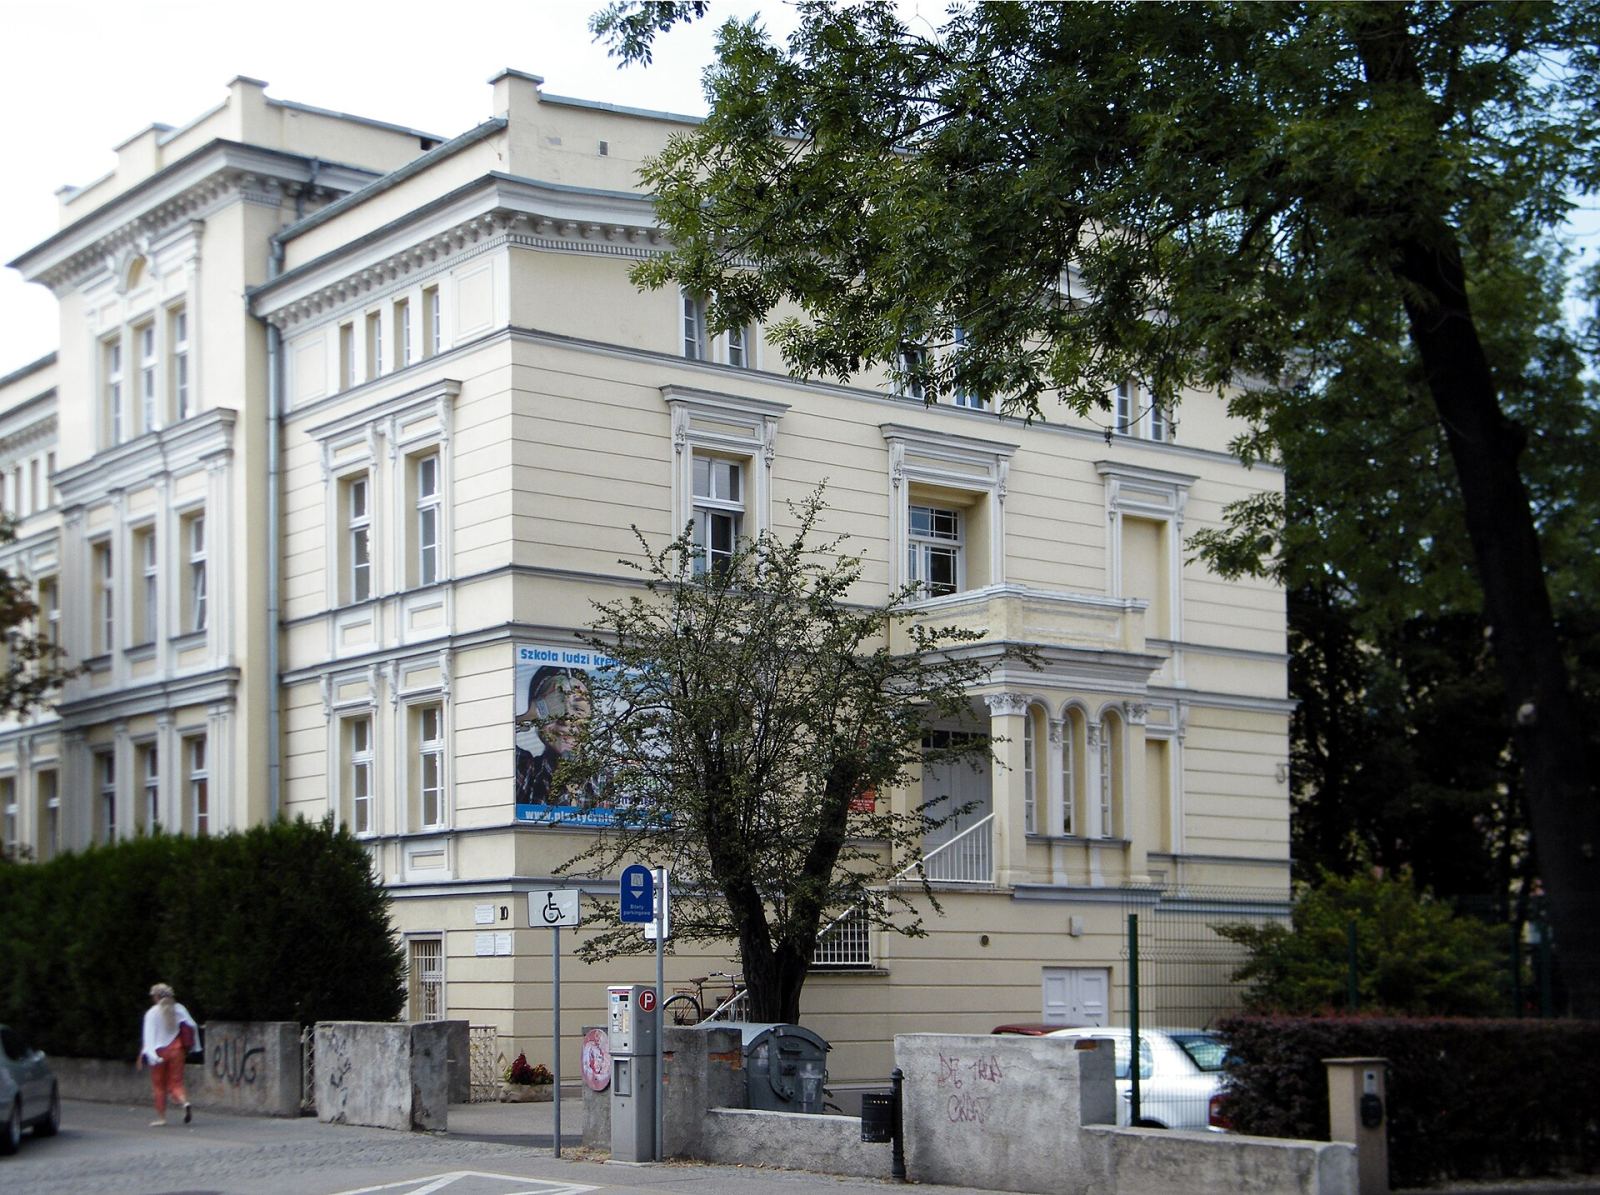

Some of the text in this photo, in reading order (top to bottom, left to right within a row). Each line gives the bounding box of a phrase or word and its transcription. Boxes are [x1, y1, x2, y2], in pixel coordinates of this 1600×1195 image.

[520, 648, 558, 661] Szkoła
[562, 651, 590, 664] ludzi
[500, 906, 508, 920] 10
[644, 993, 653, 1008] P
